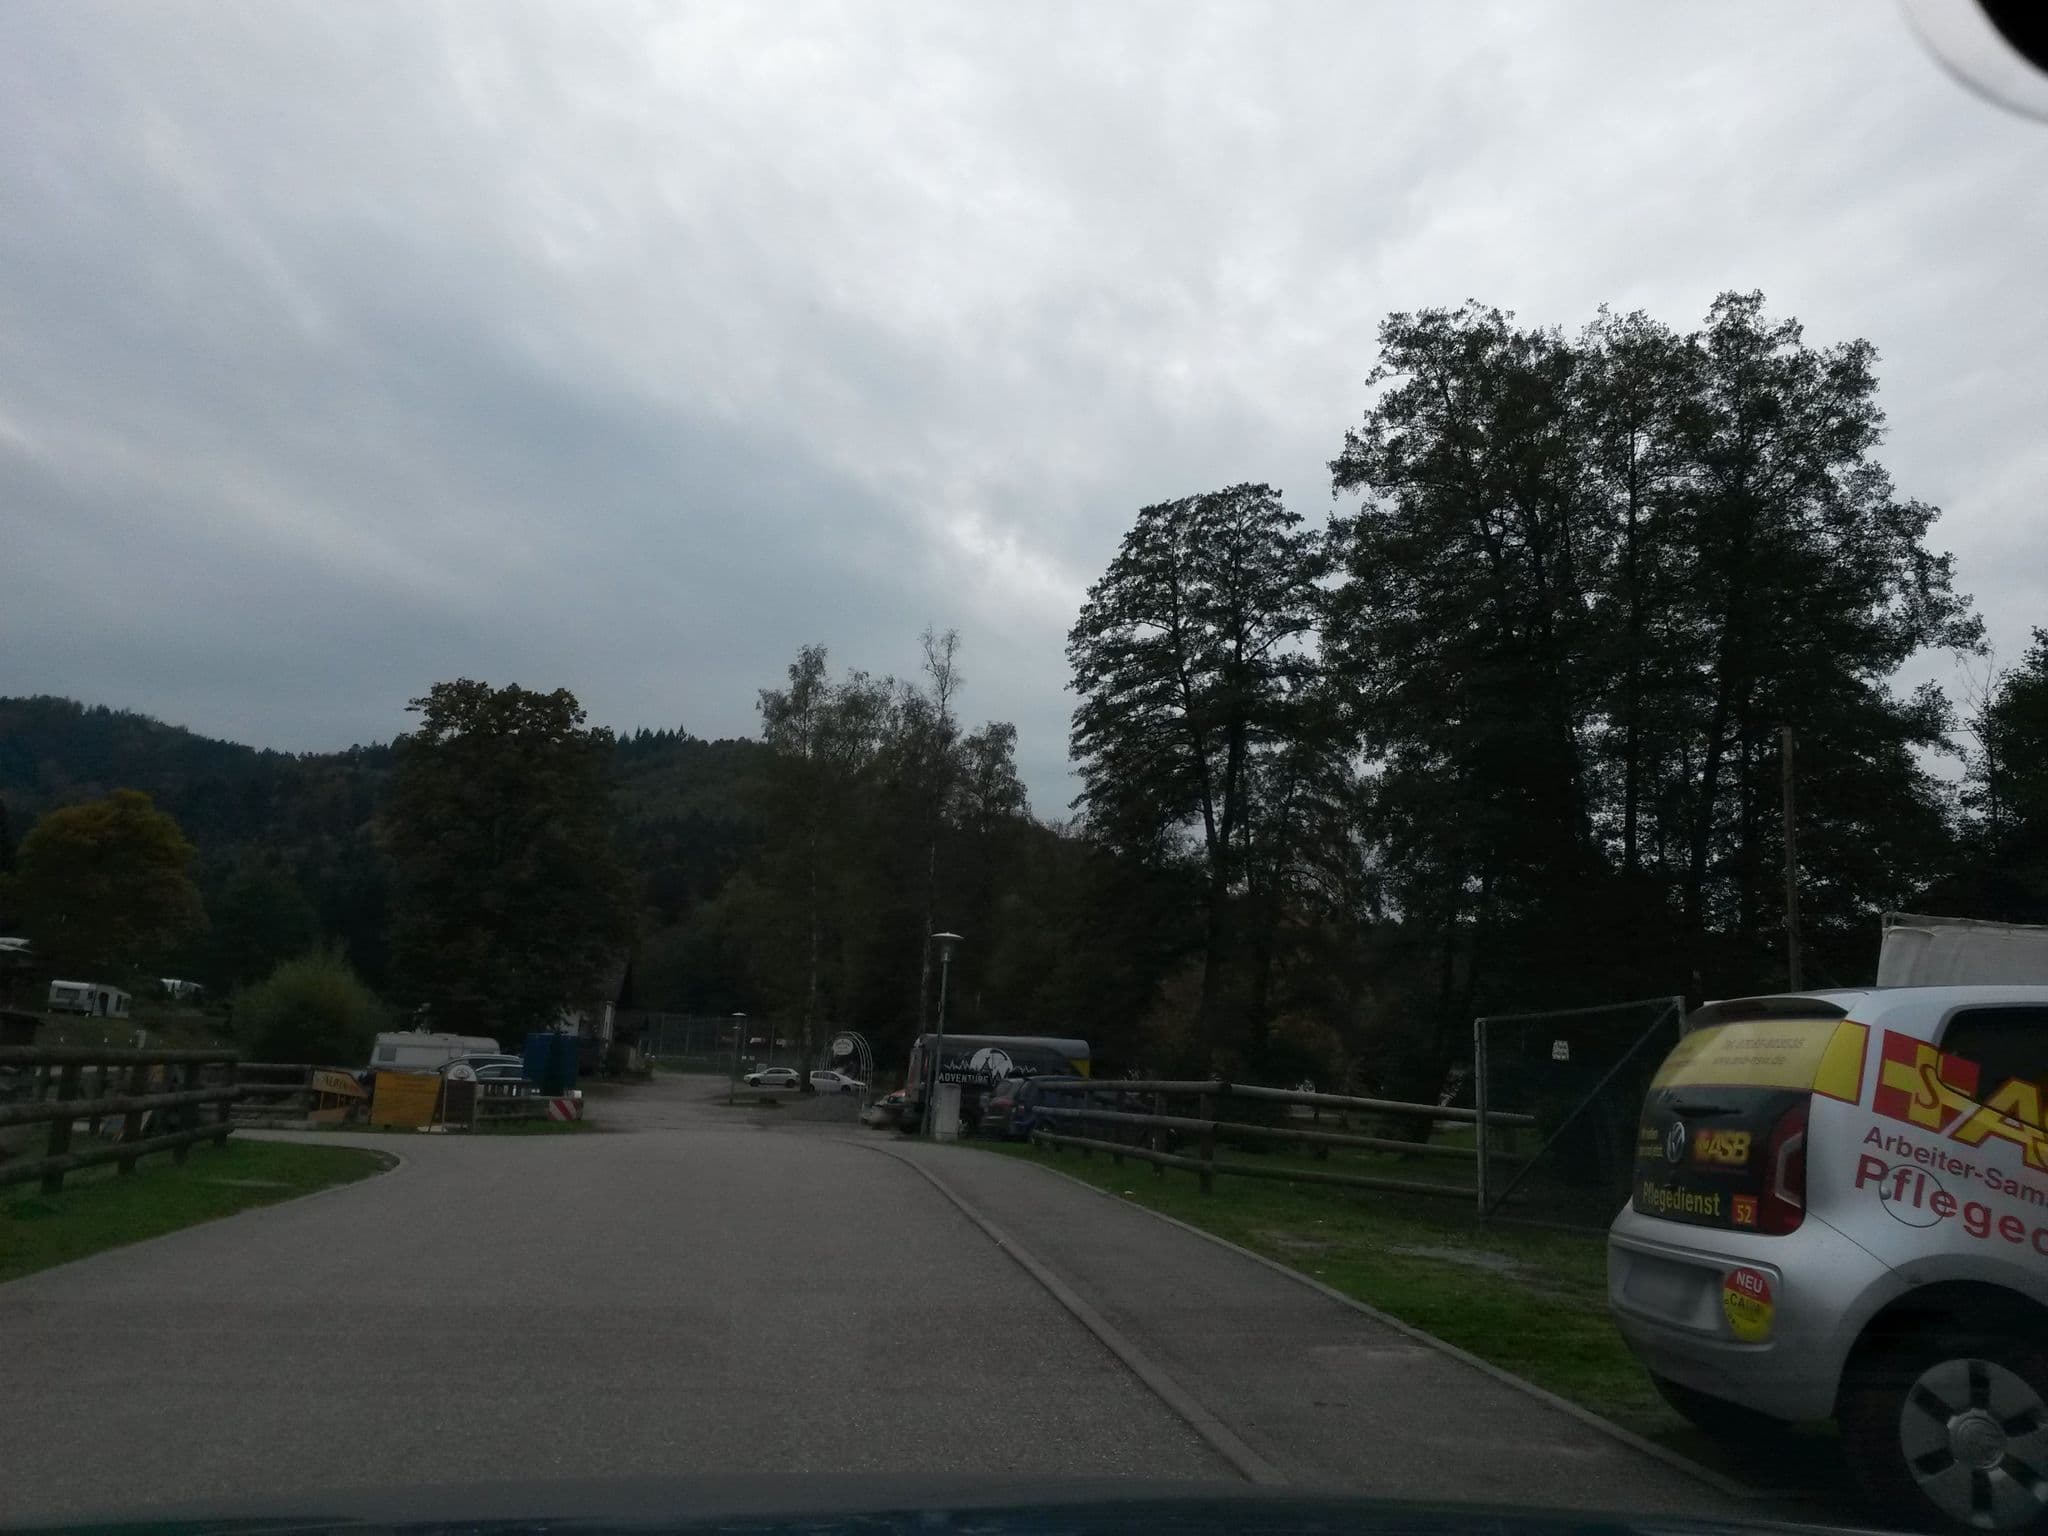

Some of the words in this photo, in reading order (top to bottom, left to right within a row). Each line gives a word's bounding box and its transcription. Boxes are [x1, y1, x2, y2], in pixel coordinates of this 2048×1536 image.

[1862, 1126, 2048, 1206] Arbeiter-Sam
[1642, 1181, 1721, 1217] Pflegedienst
[1736, 1203, 1753, 1224] 52
[1736, 1271, 1764, 1294] NEU
